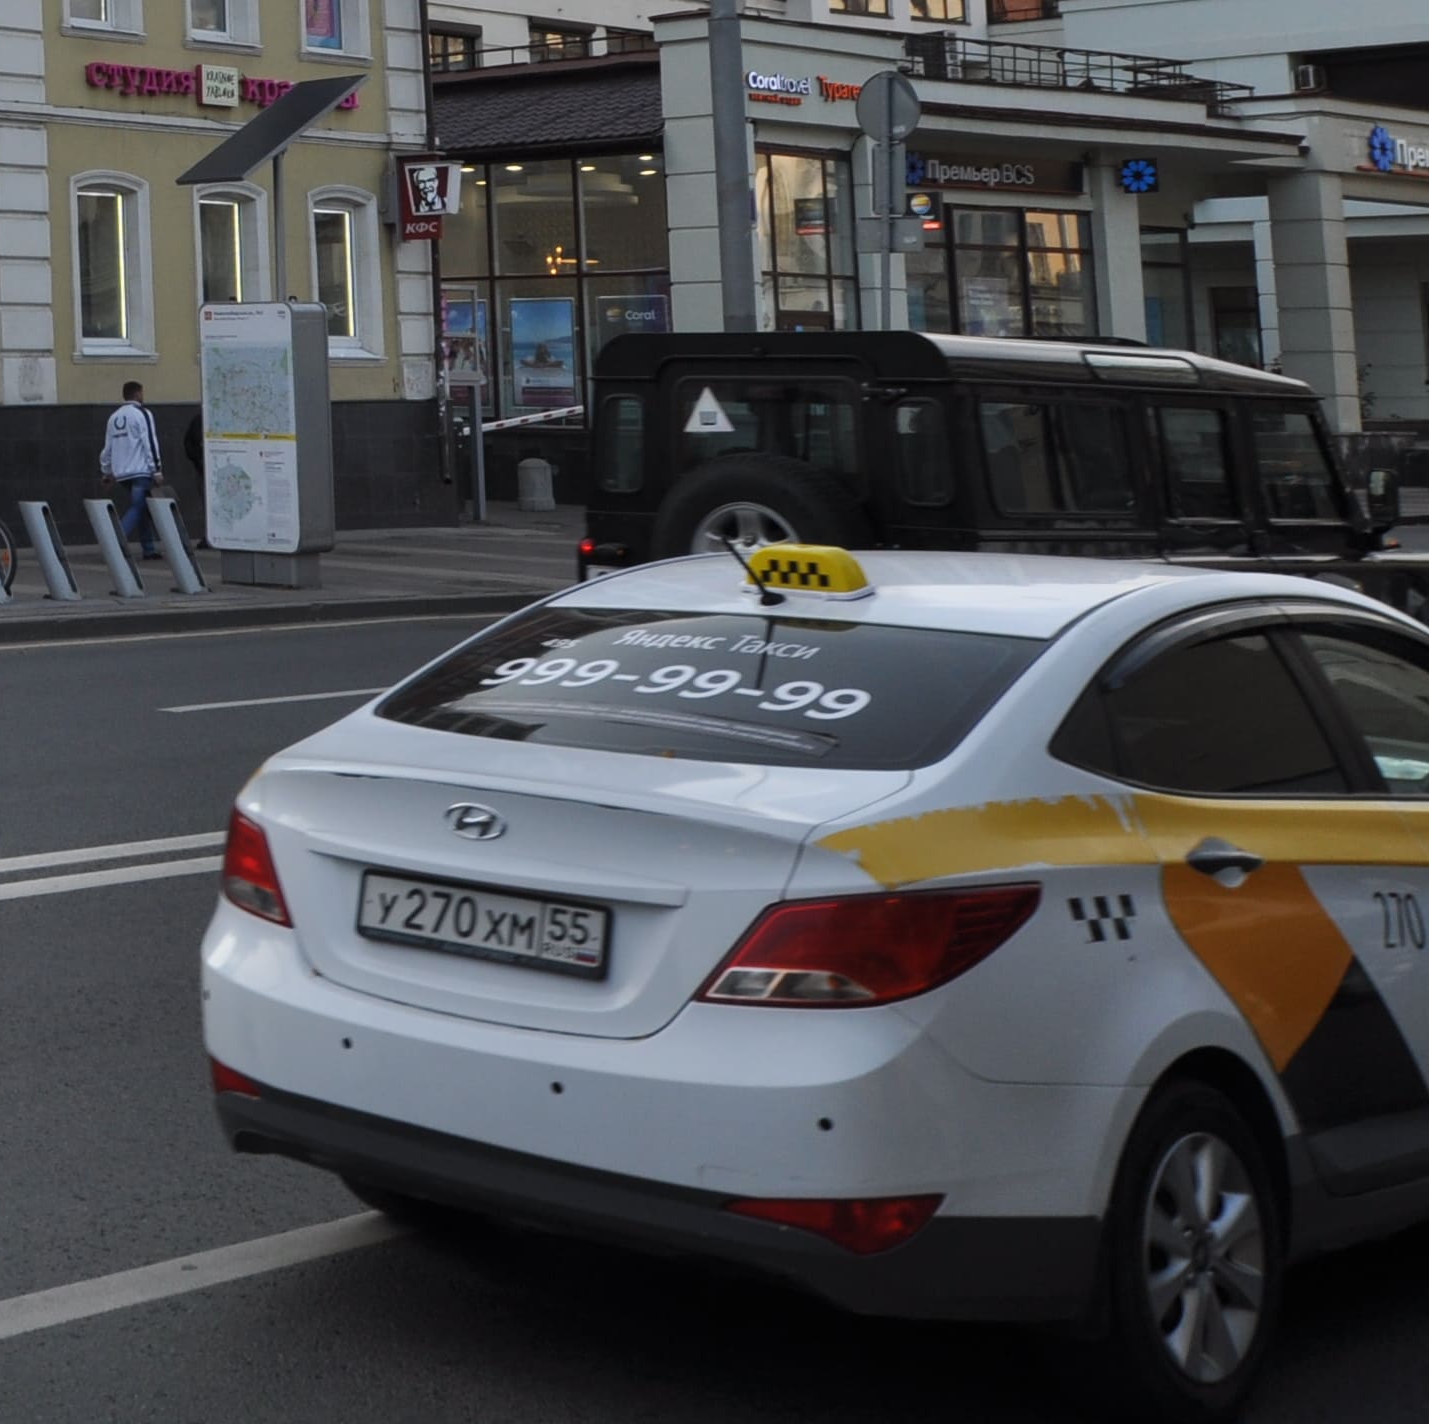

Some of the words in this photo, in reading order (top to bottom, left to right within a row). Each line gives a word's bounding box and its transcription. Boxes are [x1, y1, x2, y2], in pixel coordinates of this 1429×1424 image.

[85, 62, 197, 98] студия
[927, 159, 1000, 186] Премьер
[405, 221, 438, 234] КФС
[624, 309, 656, 321] Coral
[612, 629, 727, 651] Яндекс
[729, 633, 822, 661] Такси
[479, 657, 872, 720] 999-99-99
[546, 907, 591, 945] 55
[1372, 891, 1427, 950] 270
